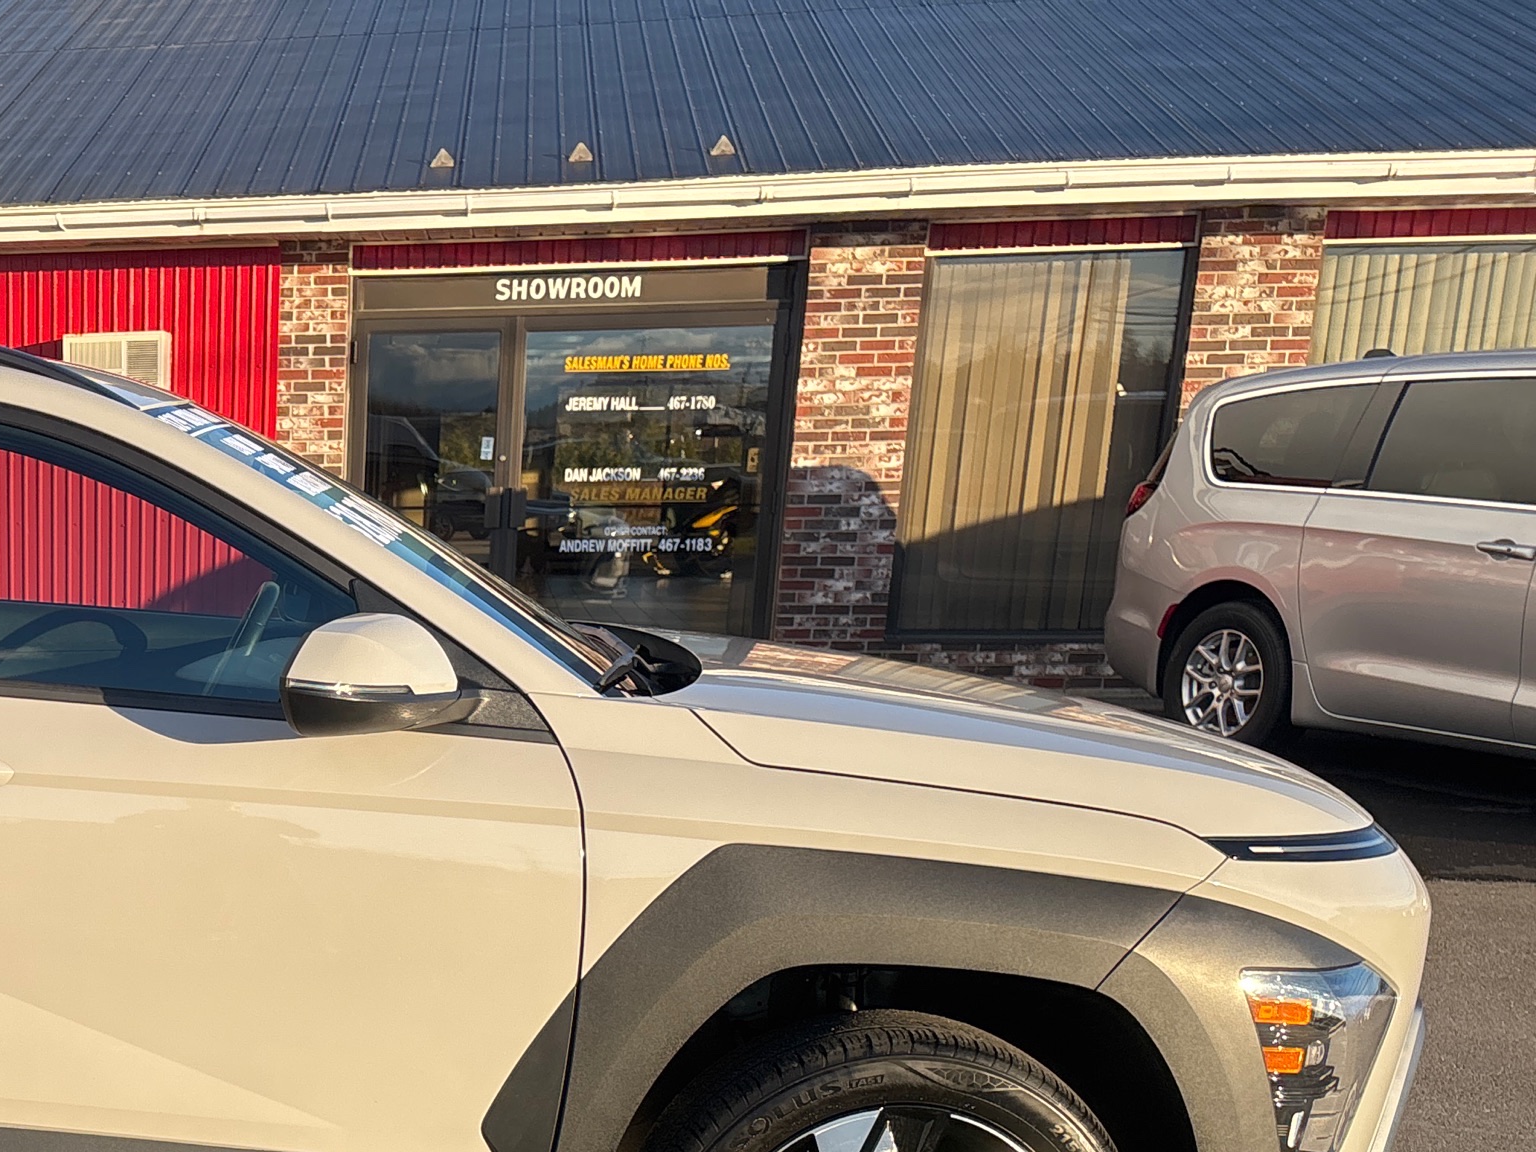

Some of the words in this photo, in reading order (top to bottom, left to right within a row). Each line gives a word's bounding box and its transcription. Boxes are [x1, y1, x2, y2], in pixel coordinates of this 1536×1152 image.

[495, 275, 642, 301] SHOWROOM
[565, 355, 630, 370] SALESMAN'S
[632, 354, 664, 370] HOME
[666, 354, 704, 369] PHONE
[705, 353, 731, 368] NOS.
[565, 396, 610, 411] JEREMY
[611, 396, 639, 411] HALL
[667, 395, 716, 410] 467-1780
[564, 467, 590, 482] DAN
[590, 467, 641, 482] JACKSON
[570, 487, 621, 501] SALES
[625, 486, 708, 500] MANAGER
[559, 539, 605, 552] ANDREW
[607, 538, 652, 552] MOFFITT
[658, 537, 712, 552] 467-1183
